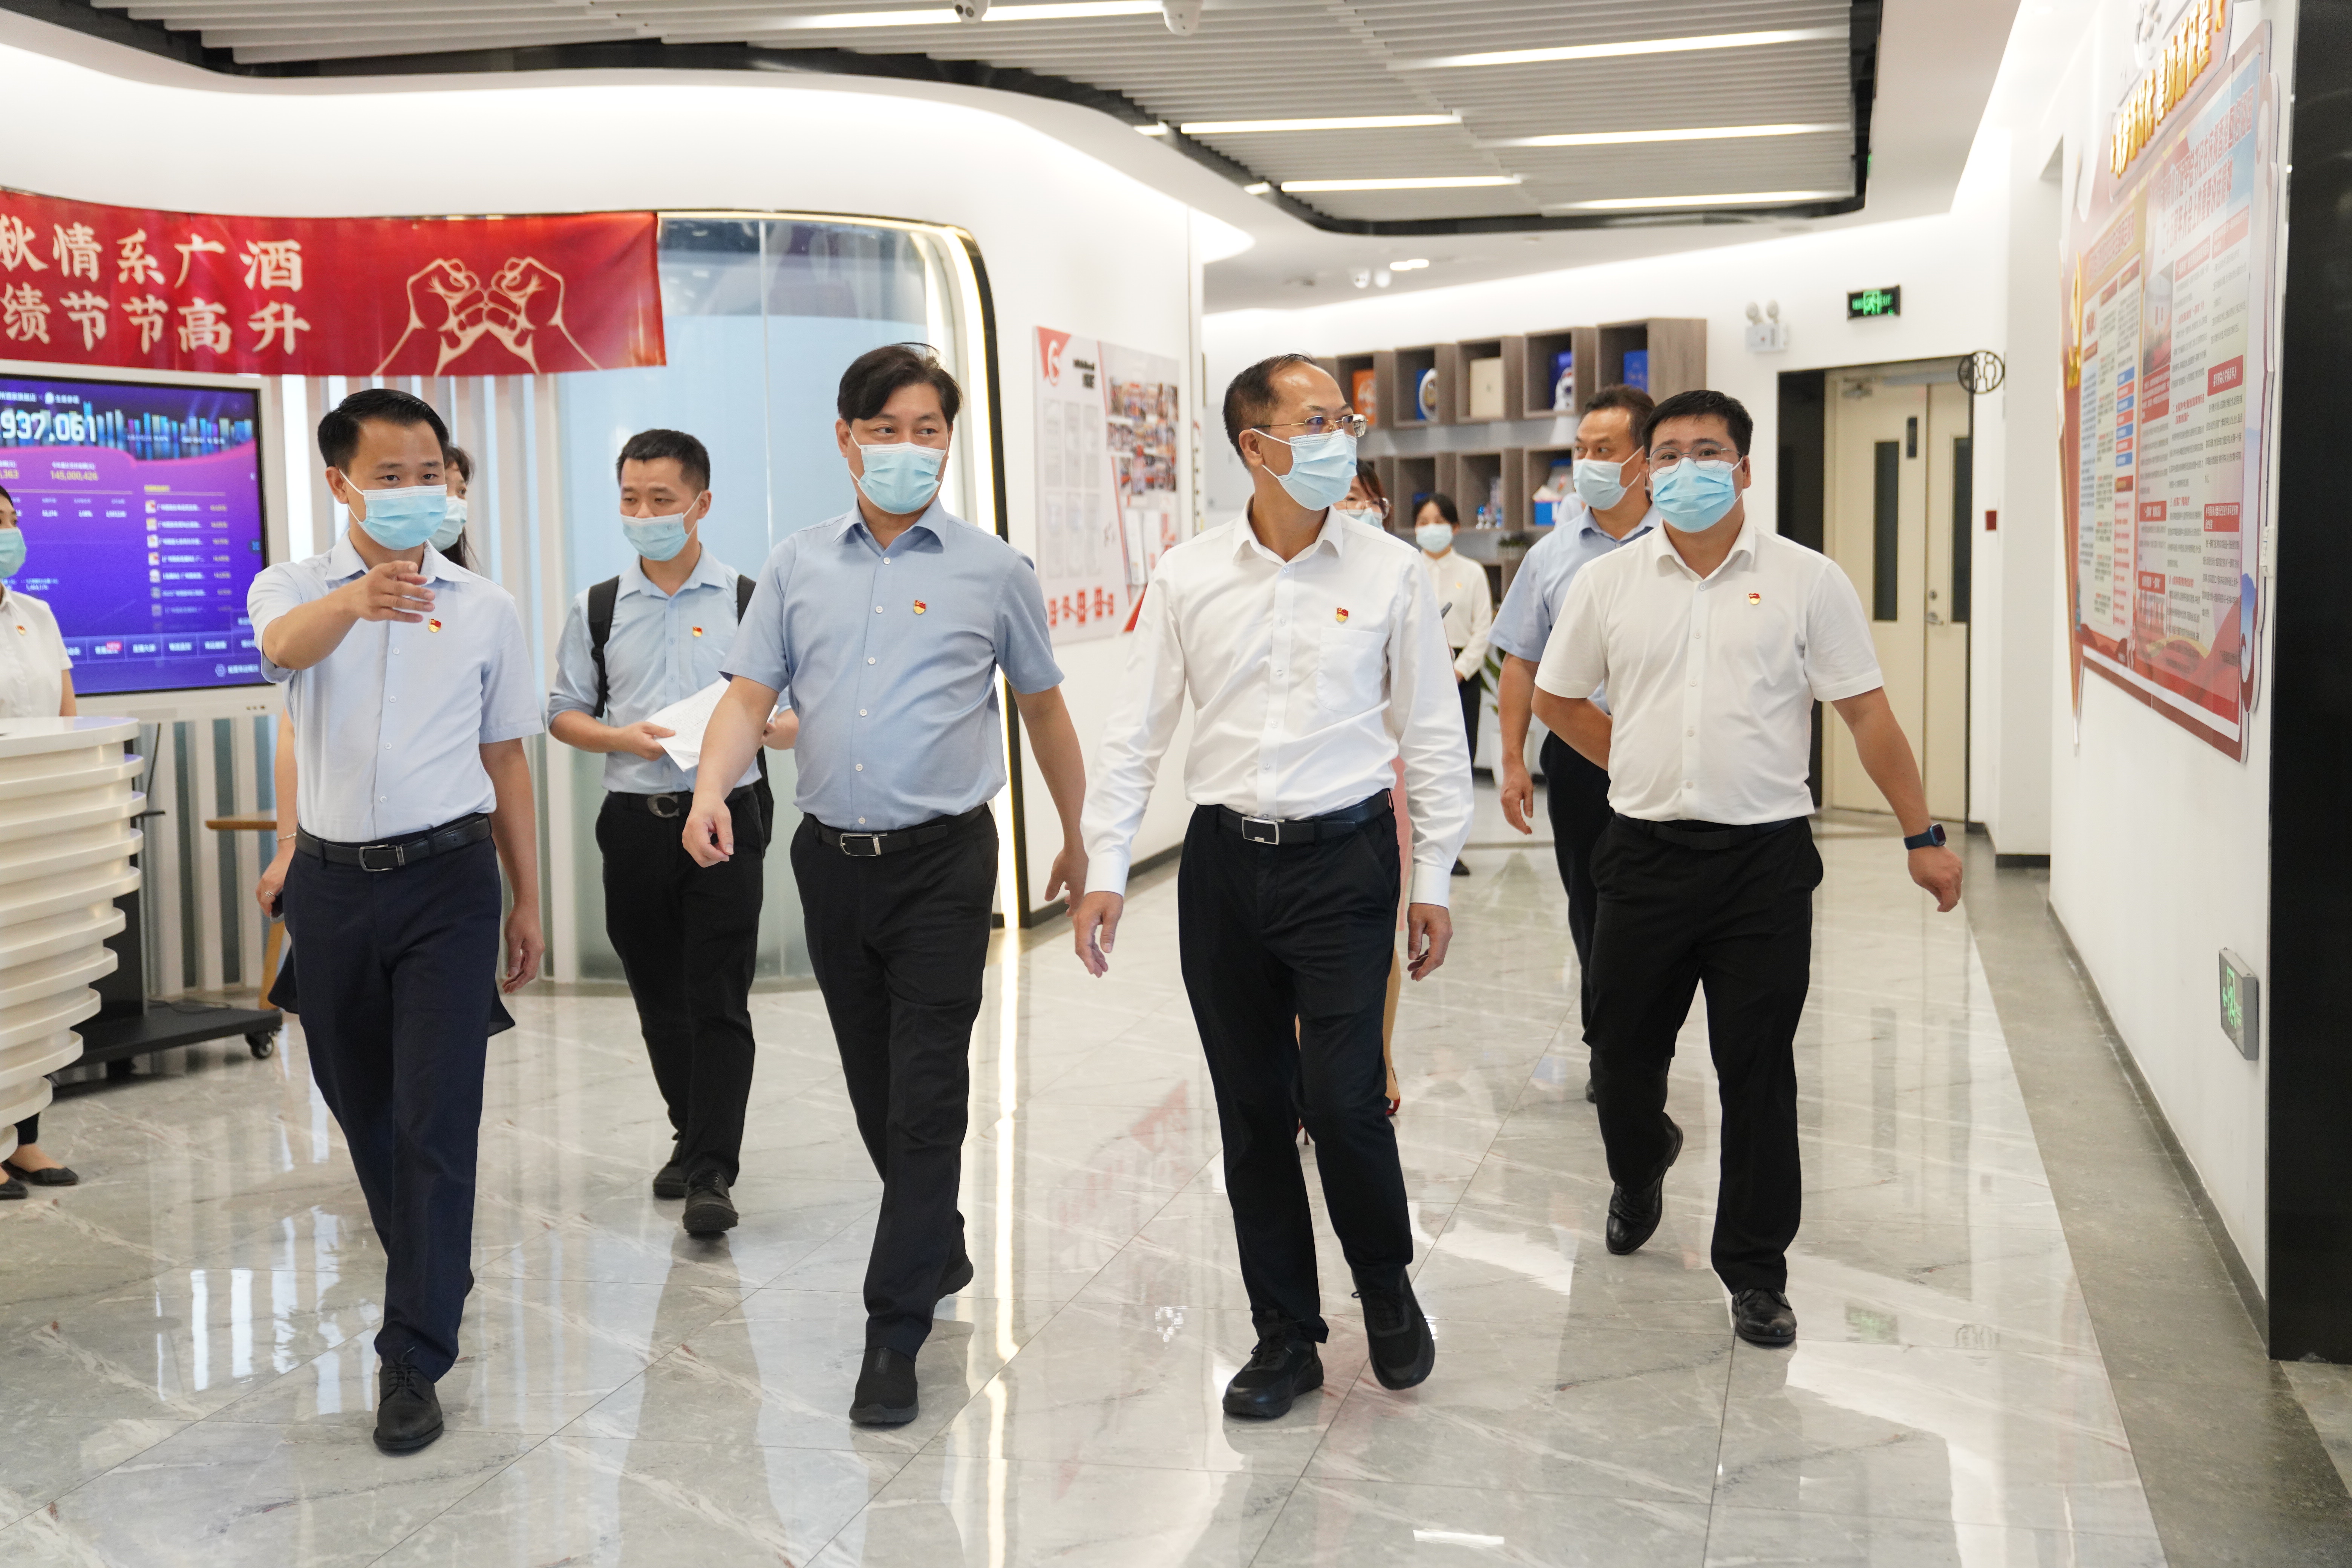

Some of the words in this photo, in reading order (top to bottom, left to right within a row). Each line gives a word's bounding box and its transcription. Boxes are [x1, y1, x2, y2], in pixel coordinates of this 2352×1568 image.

[0, 282, 311, 355] 绩节节高升
